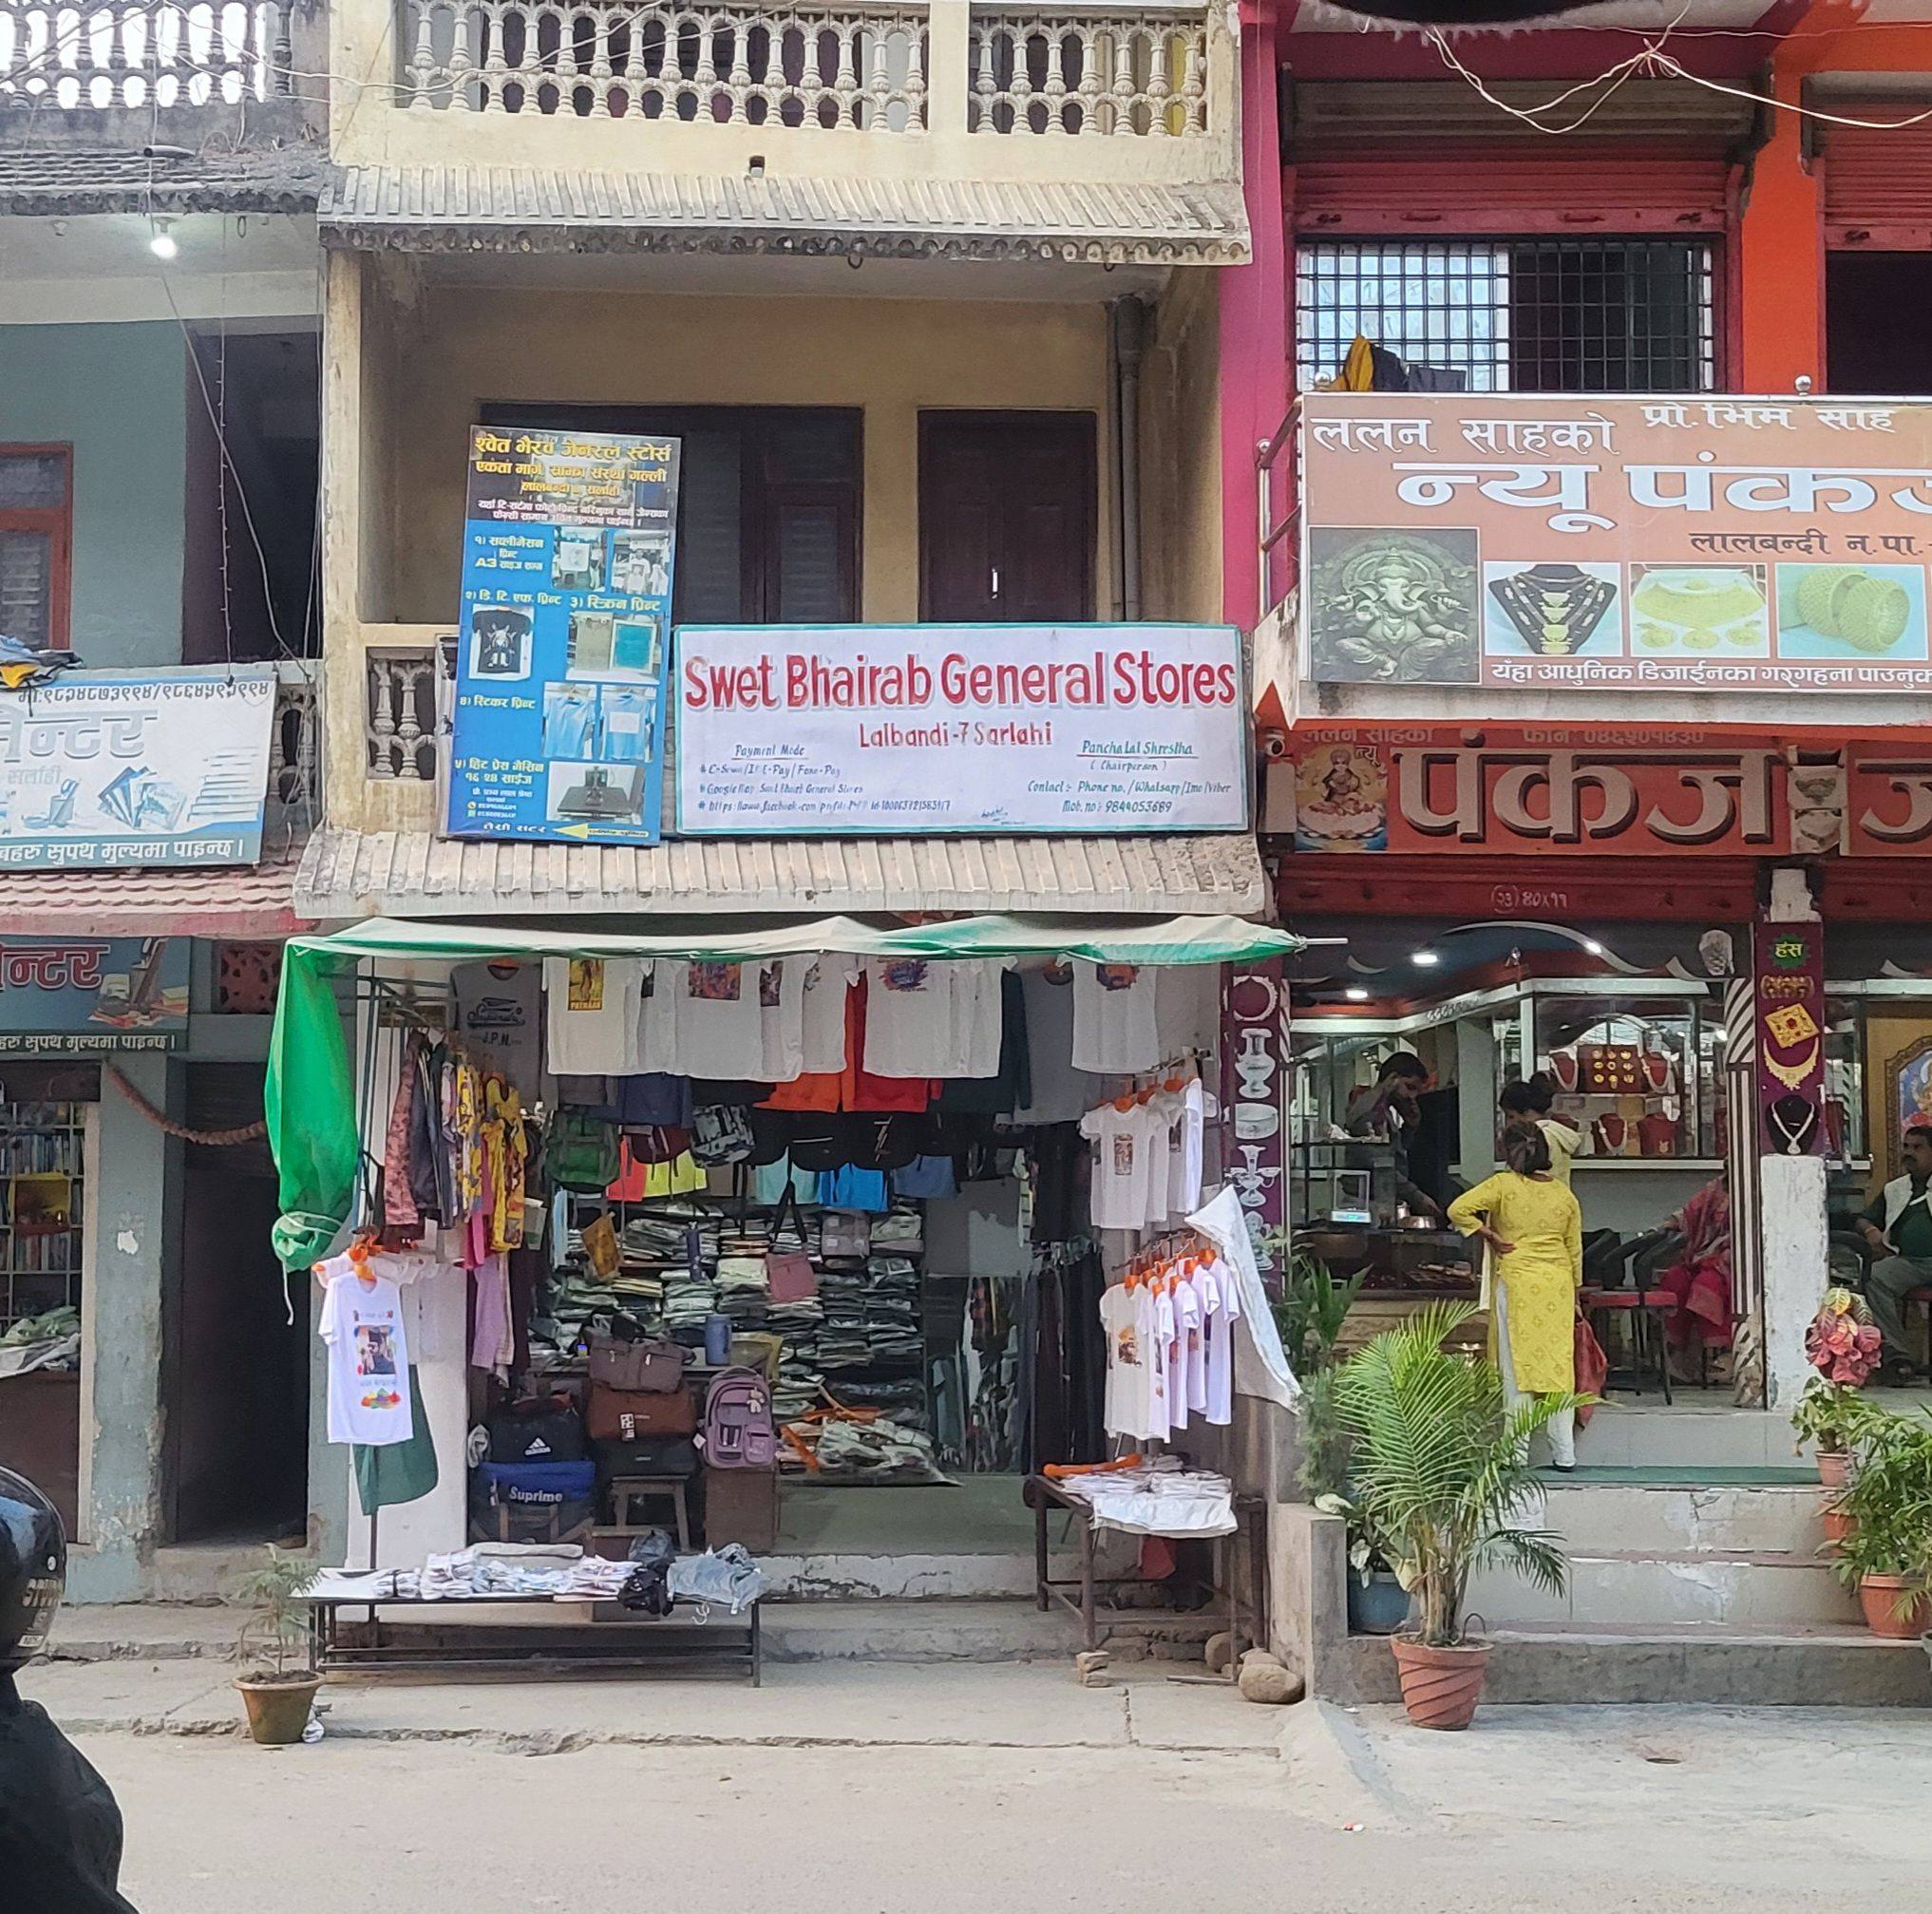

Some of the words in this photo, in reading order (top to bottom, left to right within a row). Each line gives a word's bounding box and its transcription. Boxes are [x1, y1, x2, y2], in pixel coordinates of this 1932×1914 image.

[1310, 417, 1438, 453] ललन
[1459, 410, 1620, 457] साहको
[1815, 407, 1896, 433] साह
[1392, 463, 1619, 534] न्यू
[1688, 527, 1831, 555] लालबन्दी
[684, 654, 781, 709] Swet
[786, 654, 933, 708] Bhairab
[940, 652, 1105, 706] General
[1113, 650, 1236, 705] Stores
[1537, 659, 1635, 686] आधुनिक
[1144, 741, 1194, 755] Shrestha
[1389, 730, 1780, 845] पंकज
[47, 841, 98, 866] सुपथ
[101, 840, 169, 865] मुल्यमा
[174, 838, 234, 860] पाइन्छ
[1774, 940, 1804, 957] हंस
[25, 1034, 65, 1053] सुपथ
[122, 1033, 169, 1051] पाइन्छ
